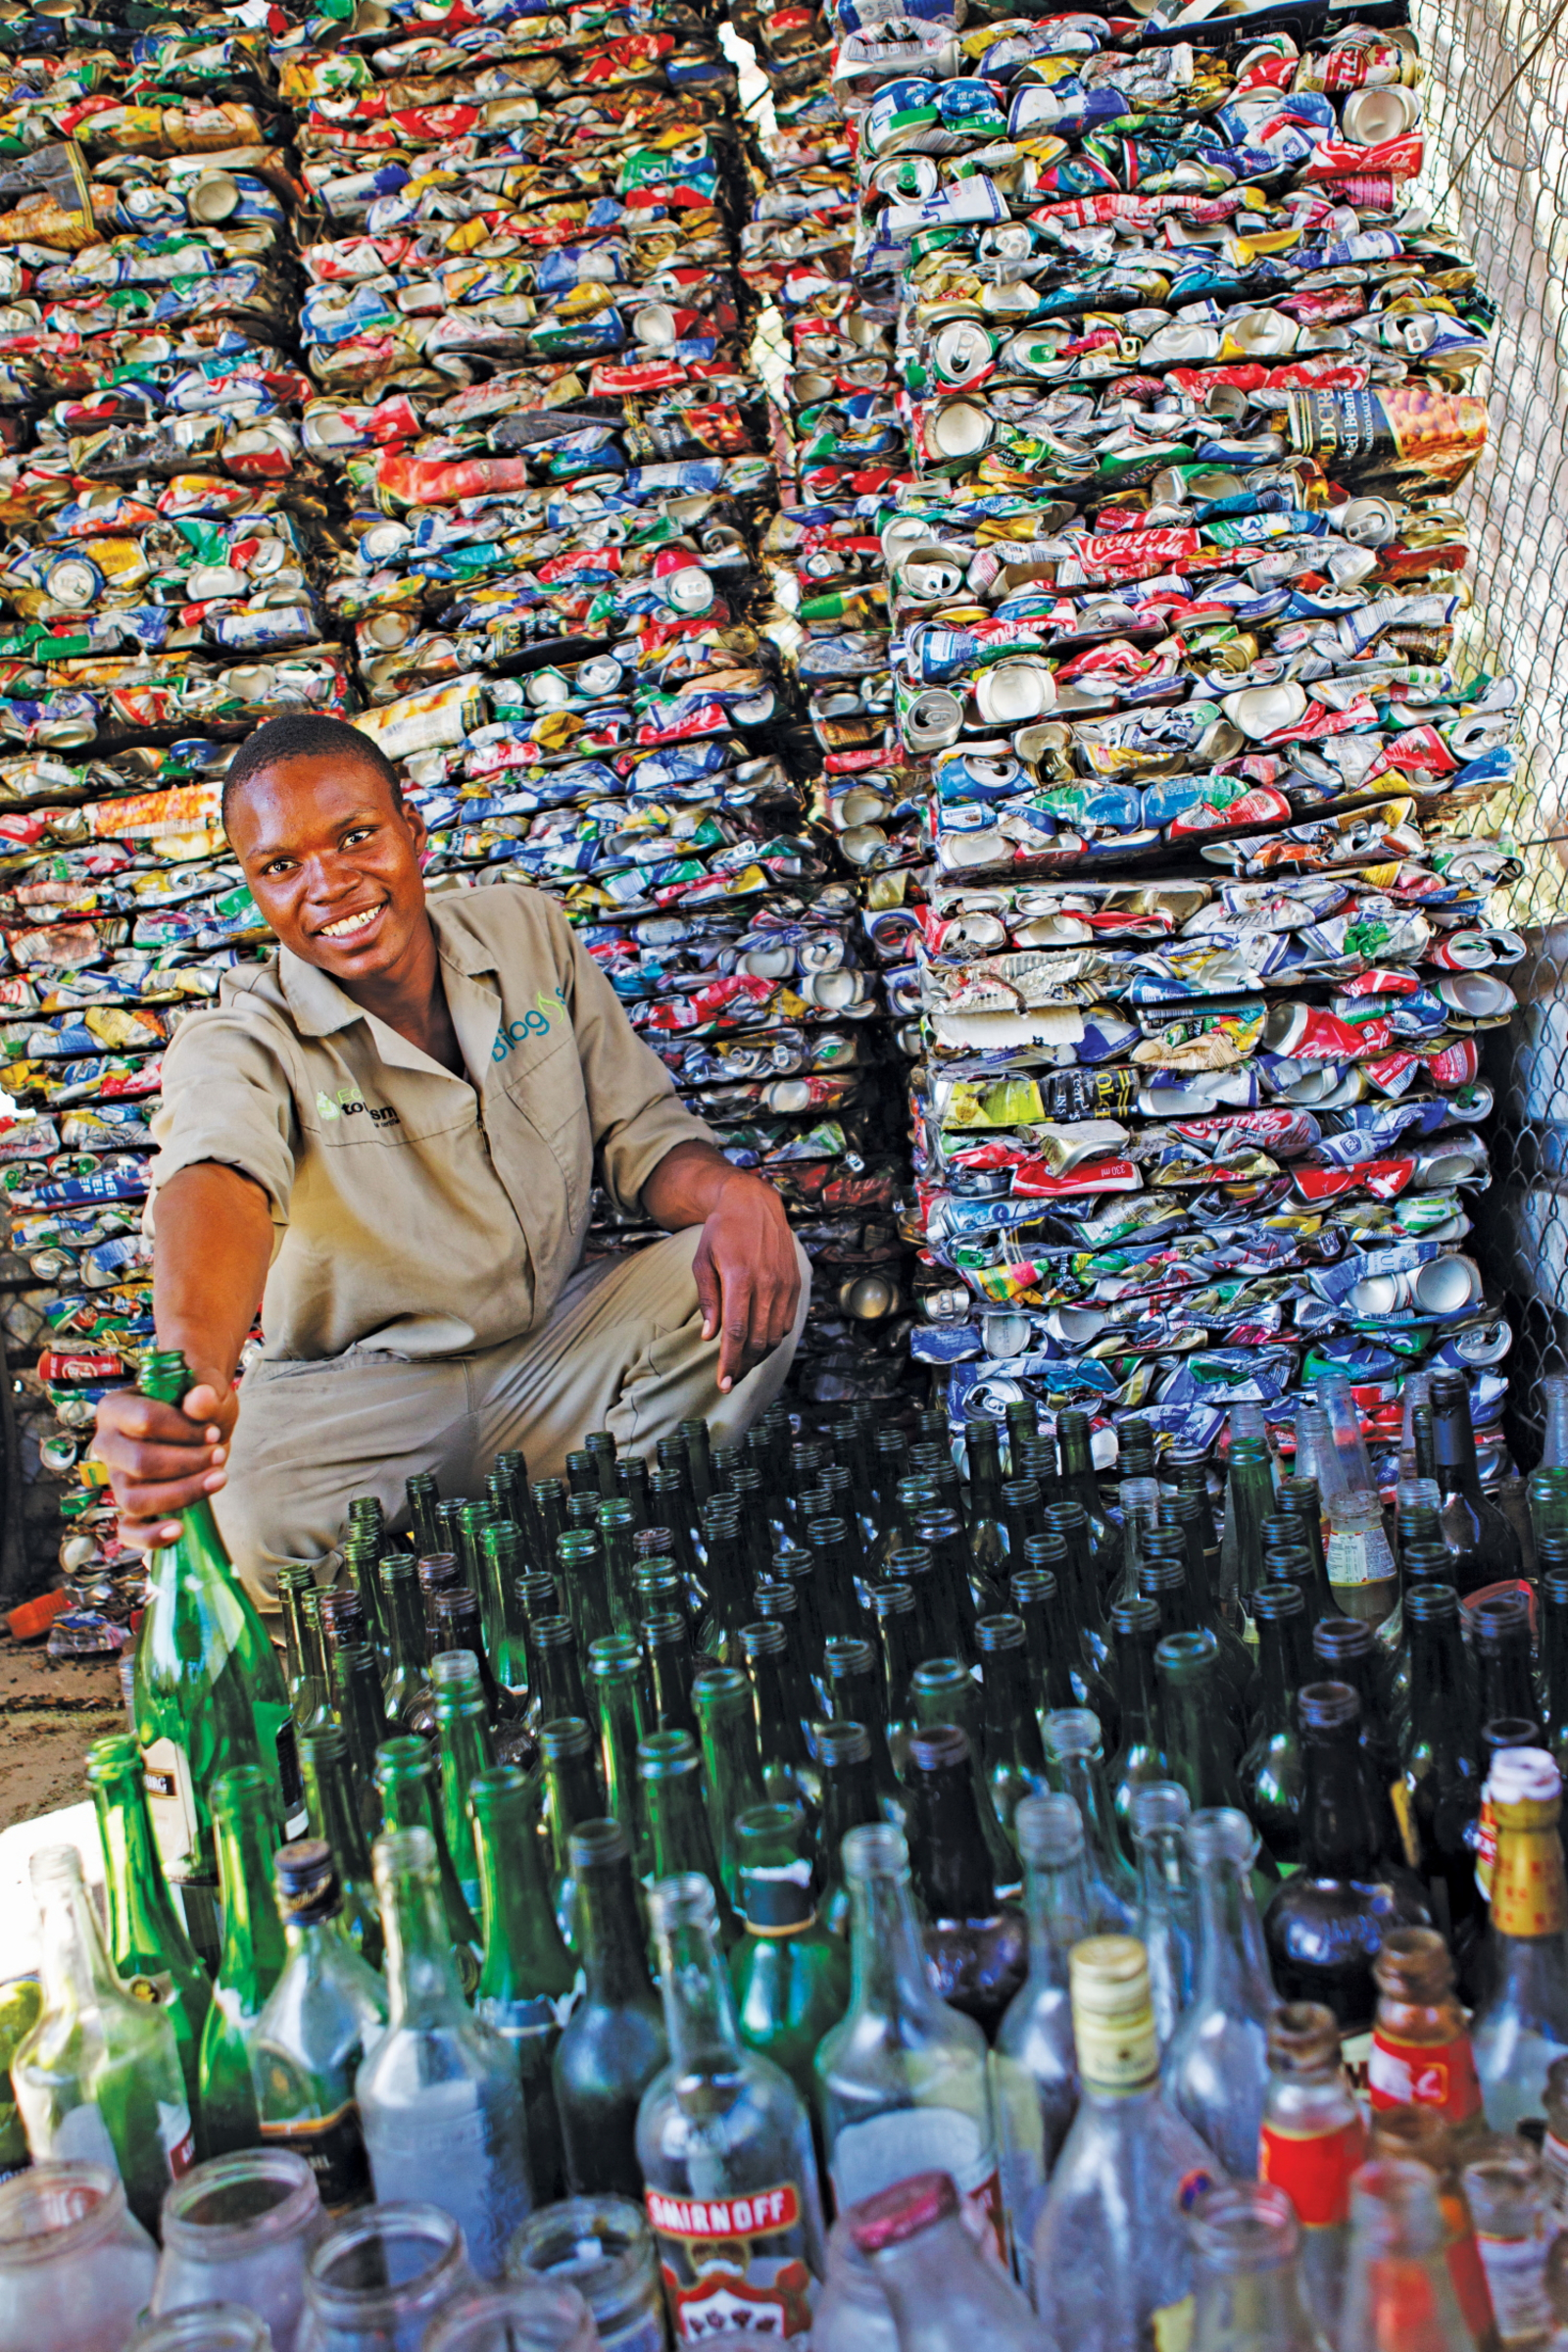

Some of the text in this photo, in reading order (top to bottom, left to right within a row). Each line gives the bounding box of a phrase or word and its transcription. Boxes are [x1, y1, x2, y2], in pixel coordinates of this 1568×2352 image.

[1085, 530, 1186, 564] Coca-Cola
[336, 1087, 362, 1104] Ec
[1101, 1164, 1126, 1177] 330 ml
[648, 2190, 785, 2233] SMIRNOFF
